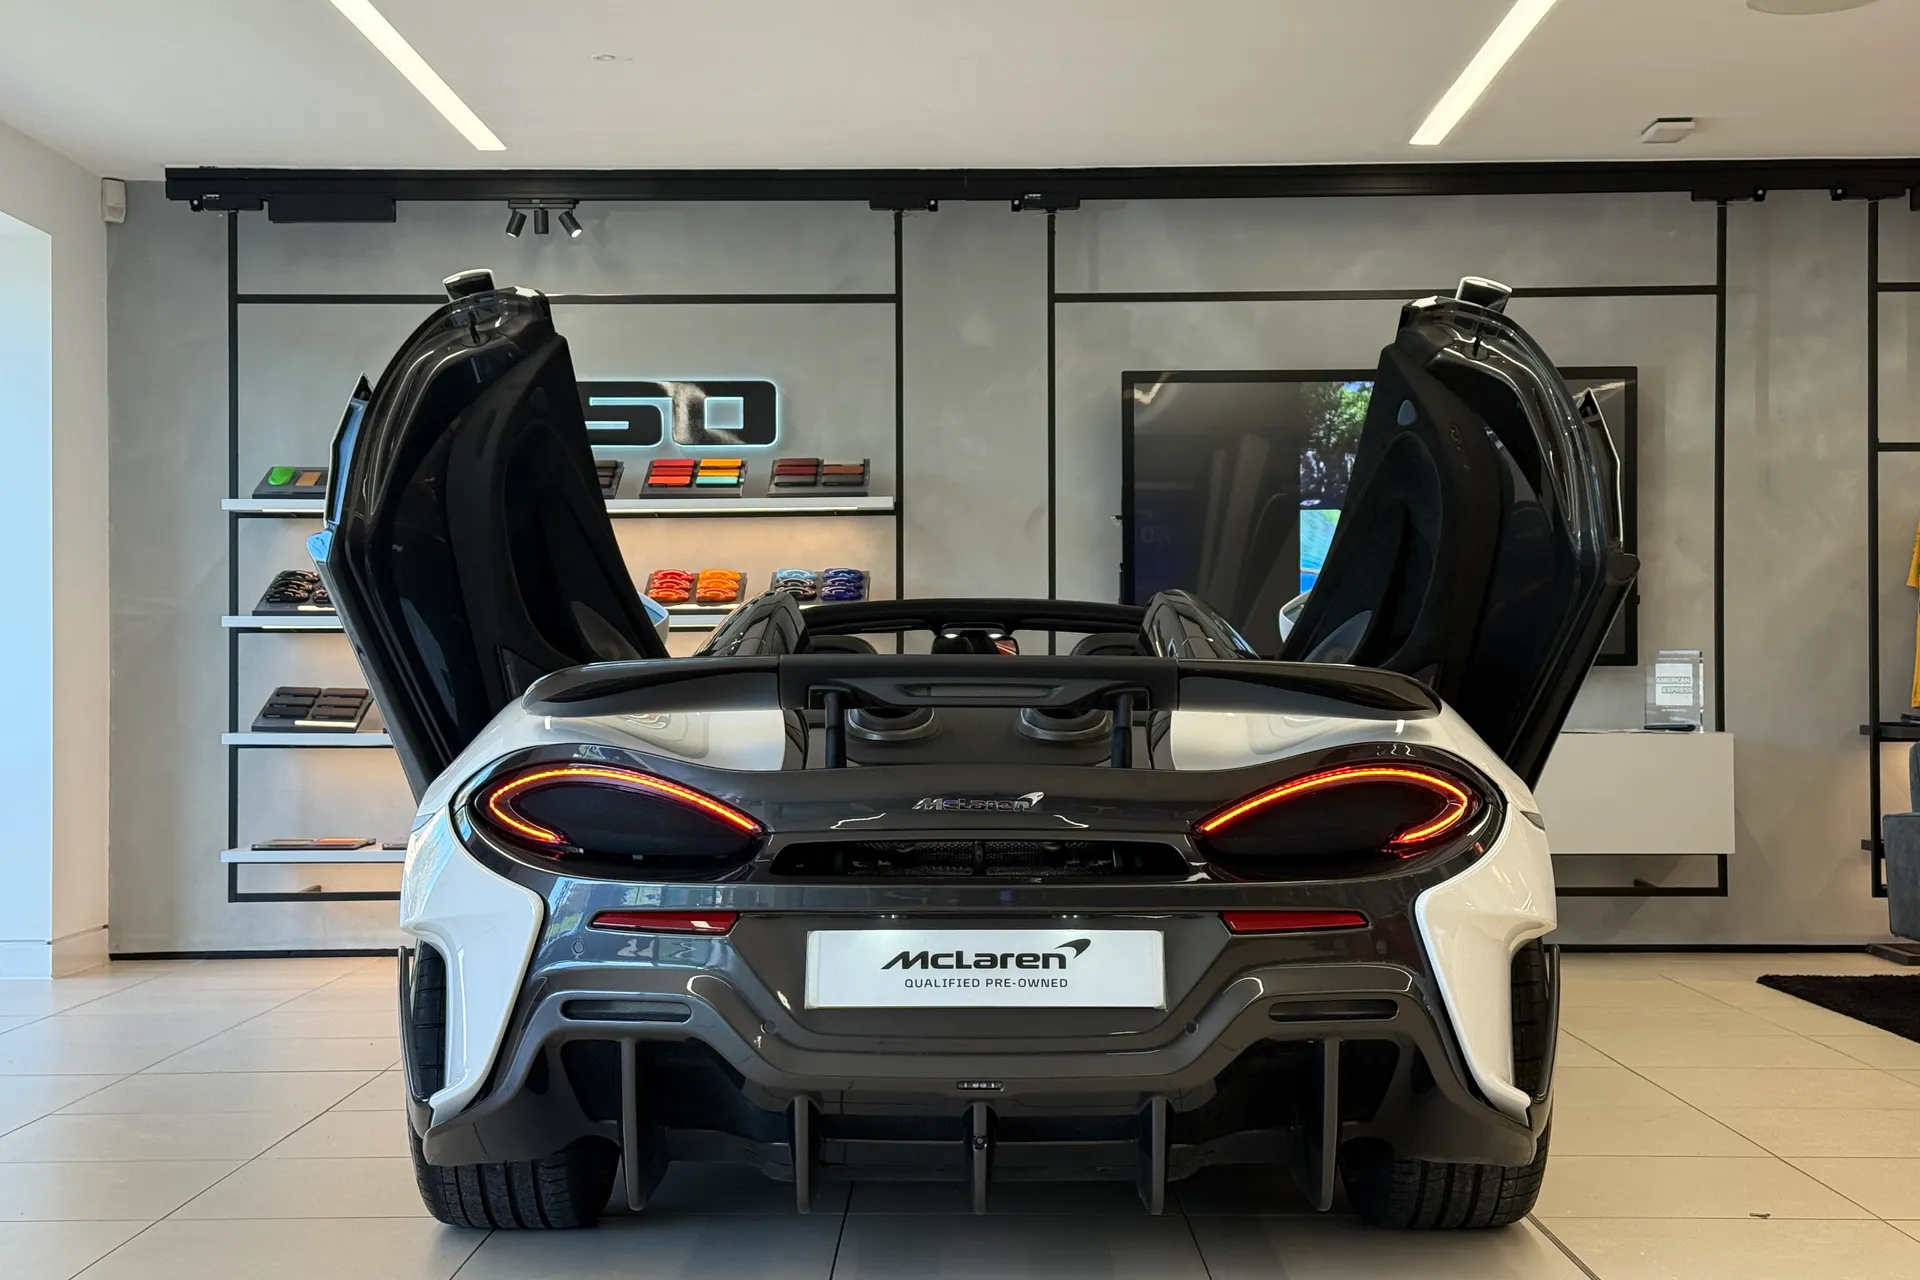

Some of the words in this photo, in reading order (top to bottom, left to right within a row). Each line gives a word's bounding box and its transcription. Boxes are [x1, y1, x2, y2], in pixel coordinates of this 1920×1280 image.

[1655, 676, 1691, 685] AMERICAN
[1661, 685, 1694, 695] EXPRESS
[911, 796, 1031, 813] McLaren
[880, 948, 1067, 971] McLaren
[903, 977, 981, 989] QUALIFIED
[985, 977, 1069, 989] PRE-OWNED
